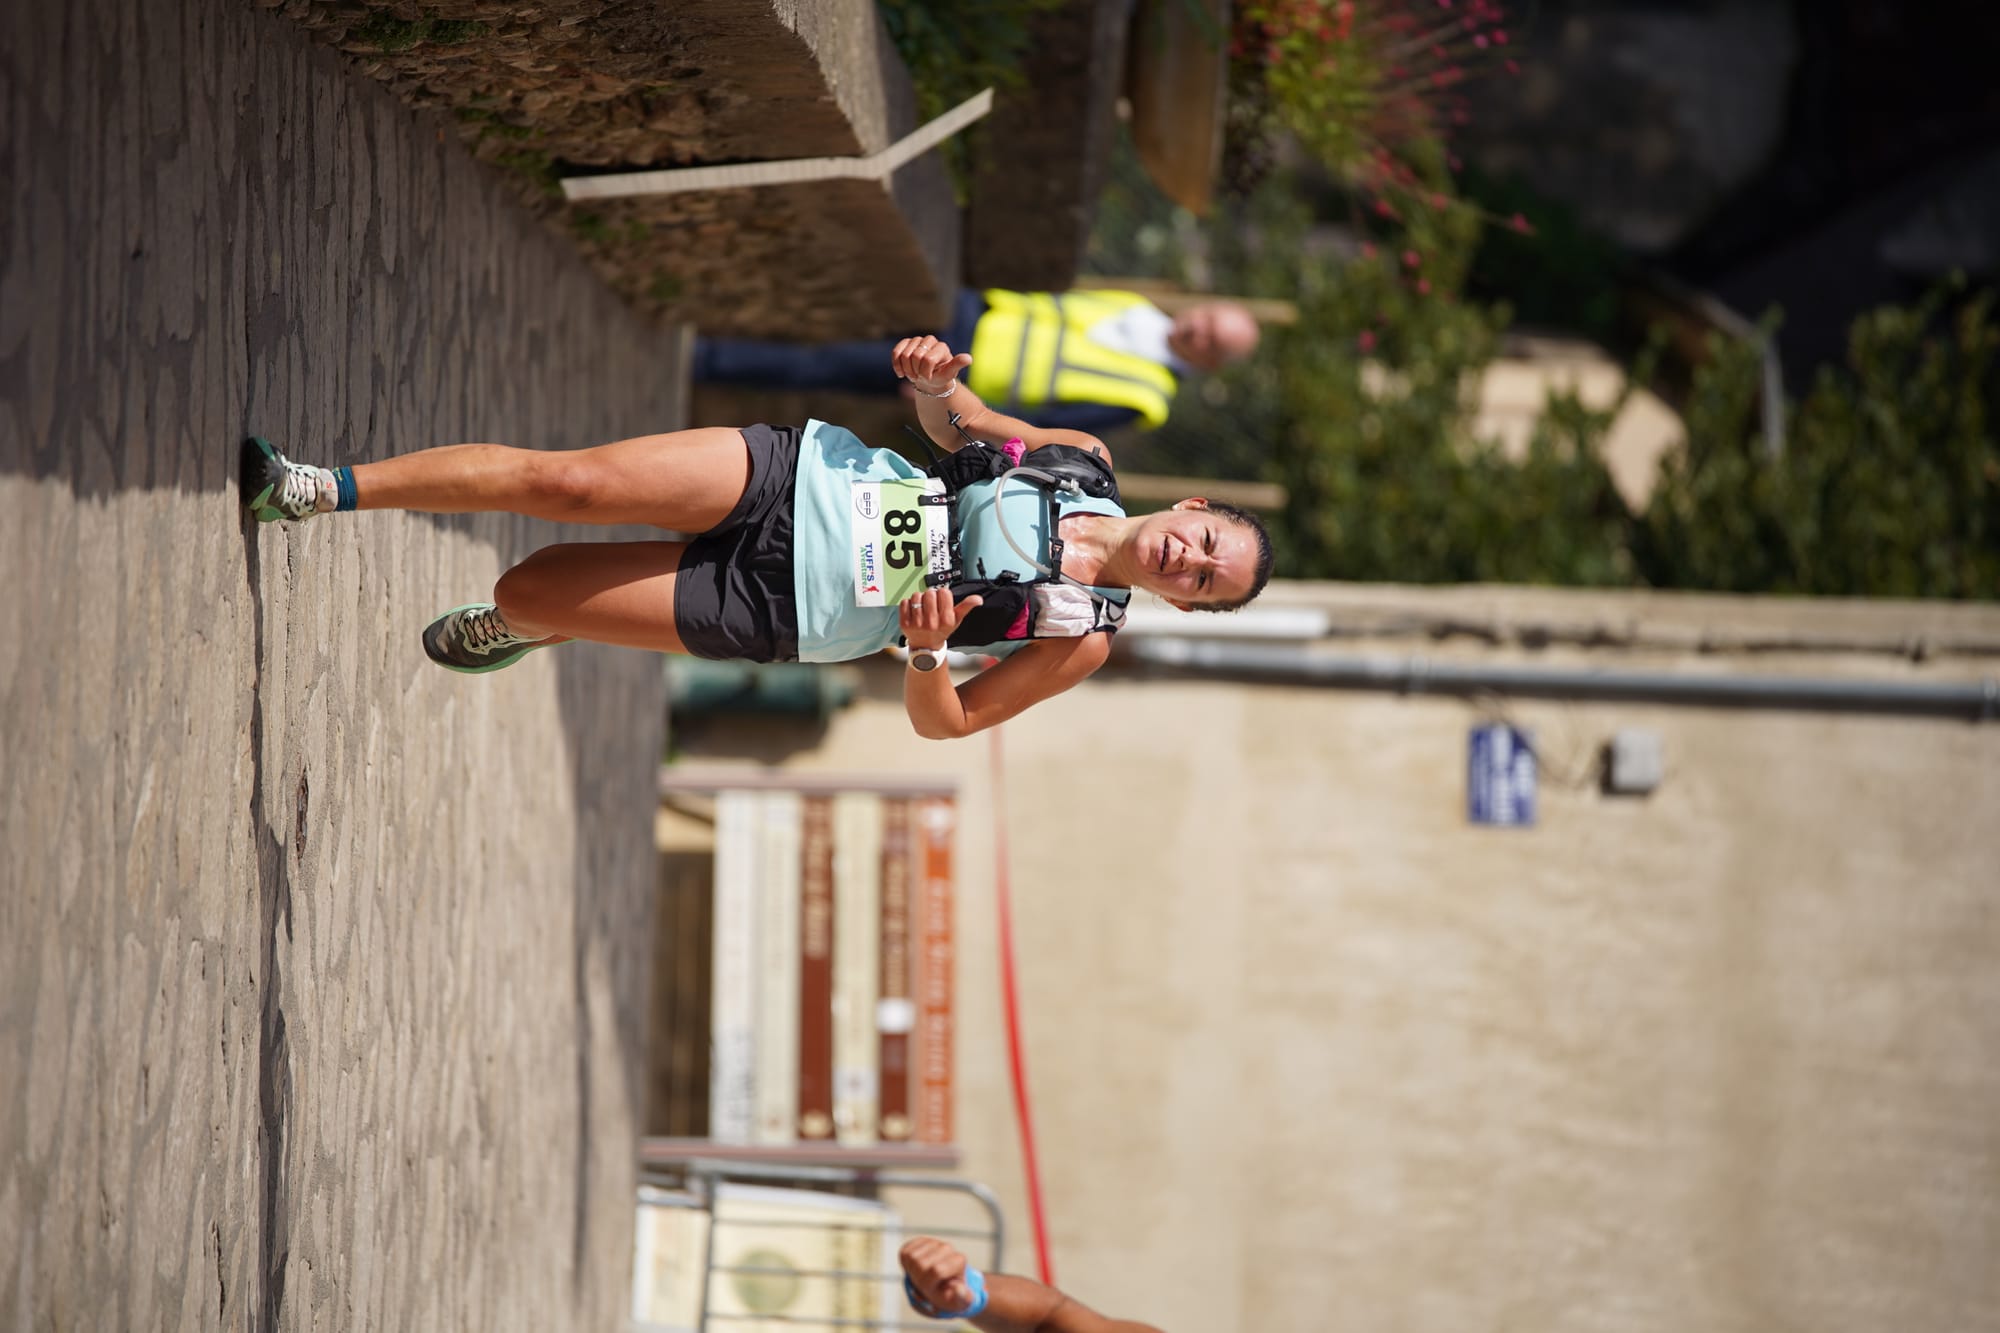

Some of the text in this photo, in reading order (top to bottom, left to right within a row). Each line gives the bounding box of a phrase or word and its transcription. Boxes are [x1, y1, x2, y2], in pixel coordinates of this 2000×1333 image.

[863, 492, 872, 516] BFP
[884, 509, 923, 570] 85
[865, 542, 875, 582] TUFF'S
